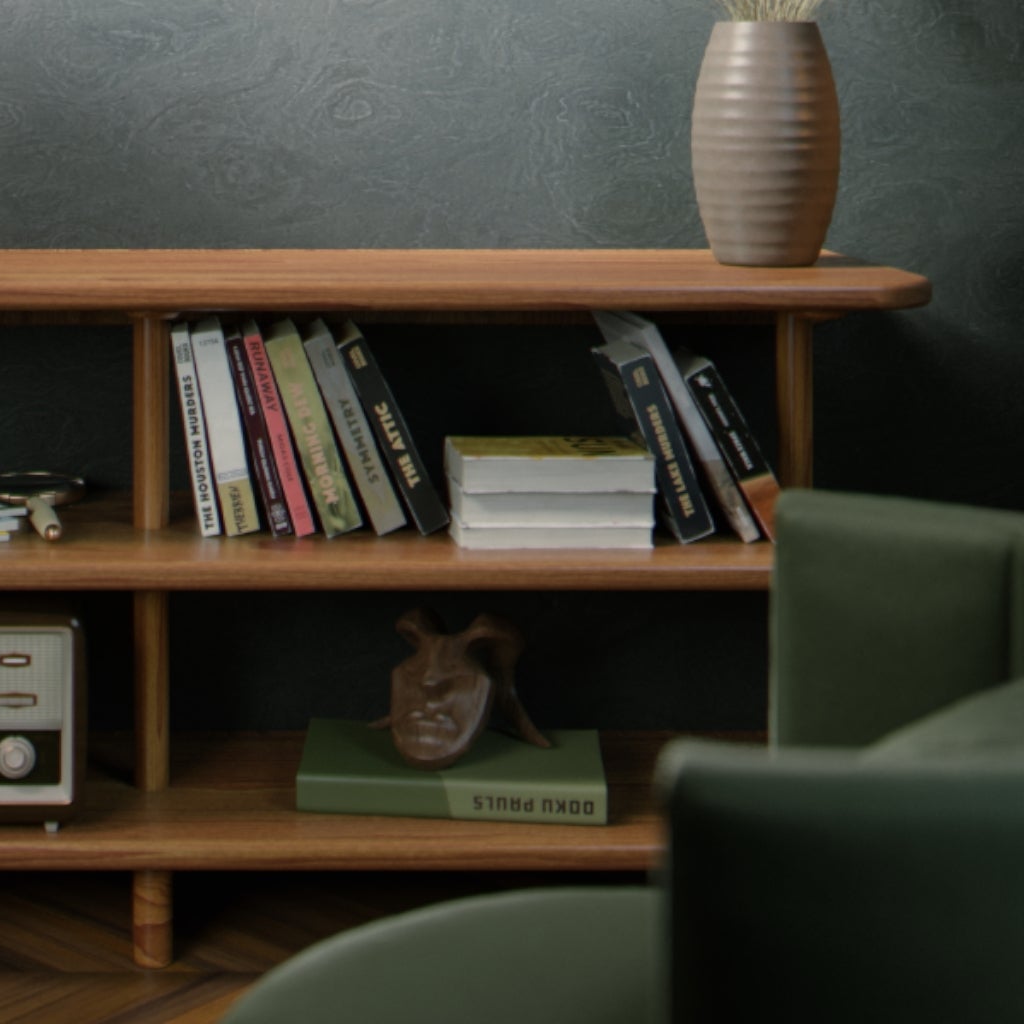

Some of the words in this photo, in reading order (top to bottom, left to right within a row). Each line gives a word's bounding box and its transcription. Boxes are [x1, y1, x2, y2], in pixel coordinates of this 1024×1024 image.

[249, 341, 278, 411] RUNAWAY
[183, 375, 200, 435] MURDERS
[374, 401, 405, 450] ATTIC
[338, 400, 380, 484] SYMMETRY
[646, 404, 676, 460] MURDERS
[192, 440, 209, 501] HOUSTON
[303, 421, 339, 504] MORNING
[397, 452, 422, 488] THE
[202, 506, 215, 530] THE
[678, 491, 695, 518] THE
[473, 795, 535, 813] PAULS
[541, 798, 594, 816] DOKU
